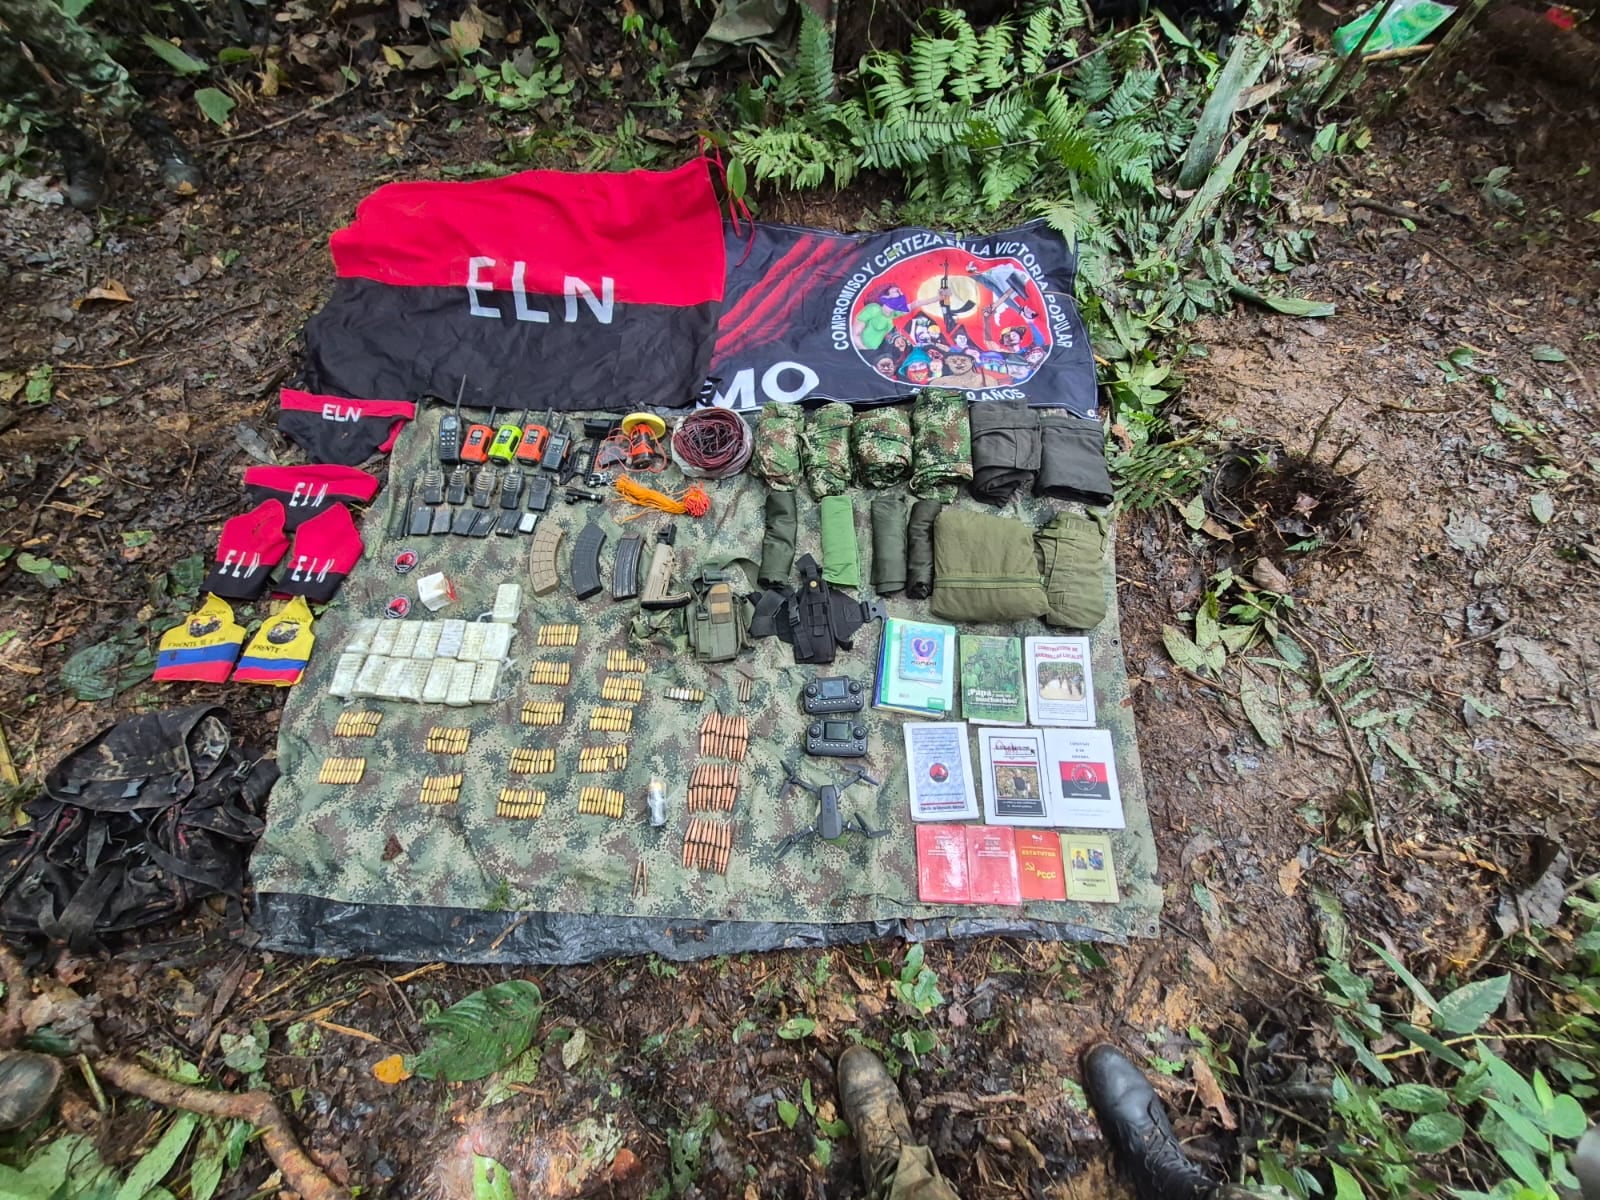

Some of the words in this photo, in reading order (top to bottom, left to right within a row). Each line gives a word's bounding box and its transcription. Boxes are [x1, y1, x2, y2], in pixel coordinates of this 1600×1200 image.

[467, 256, 615, 324] ELN
[831, 273, 867, 351] COMPROMISO
[861, 262, 875, 275] Y
[874, 233, 944, 267] CERTEZA
[970, 243, 990, 255] LA
[994, 241, 1049, 291] VICTORIA
[1044, 294, 1073, 348] POPULAR
[981, 388, 1026, 401] AÑOS
[322, 403, 362, 422] ELN
[289, 482, 328, 508] ELN
[218, 550, 261, 579] ELN
[291, 555, 335, 583] ELN
